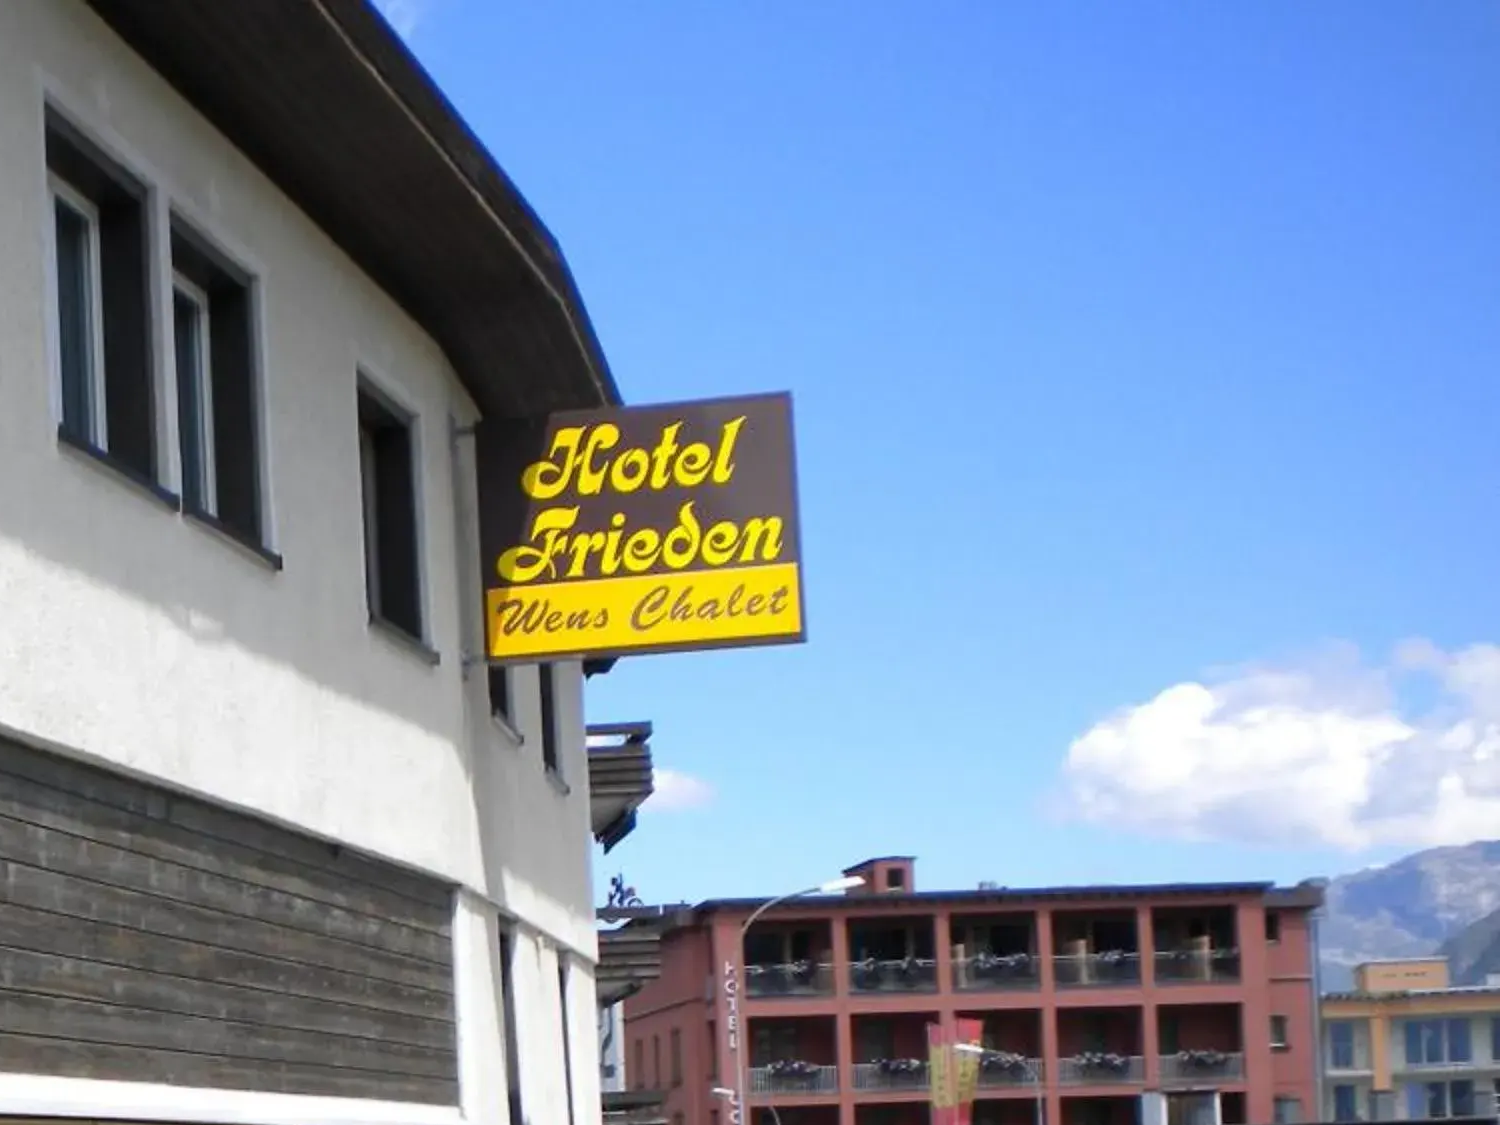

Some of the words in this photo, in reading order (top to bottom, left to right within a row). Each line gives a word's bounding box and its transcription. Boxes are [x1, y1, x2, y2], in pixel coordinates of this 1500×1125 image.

[521, 415, 747, 499] Hotel
[497, 501, 783, 583] Frieden
[497, 597, 609, 638] Wens
[629, 583, 789, 632] Chalet
